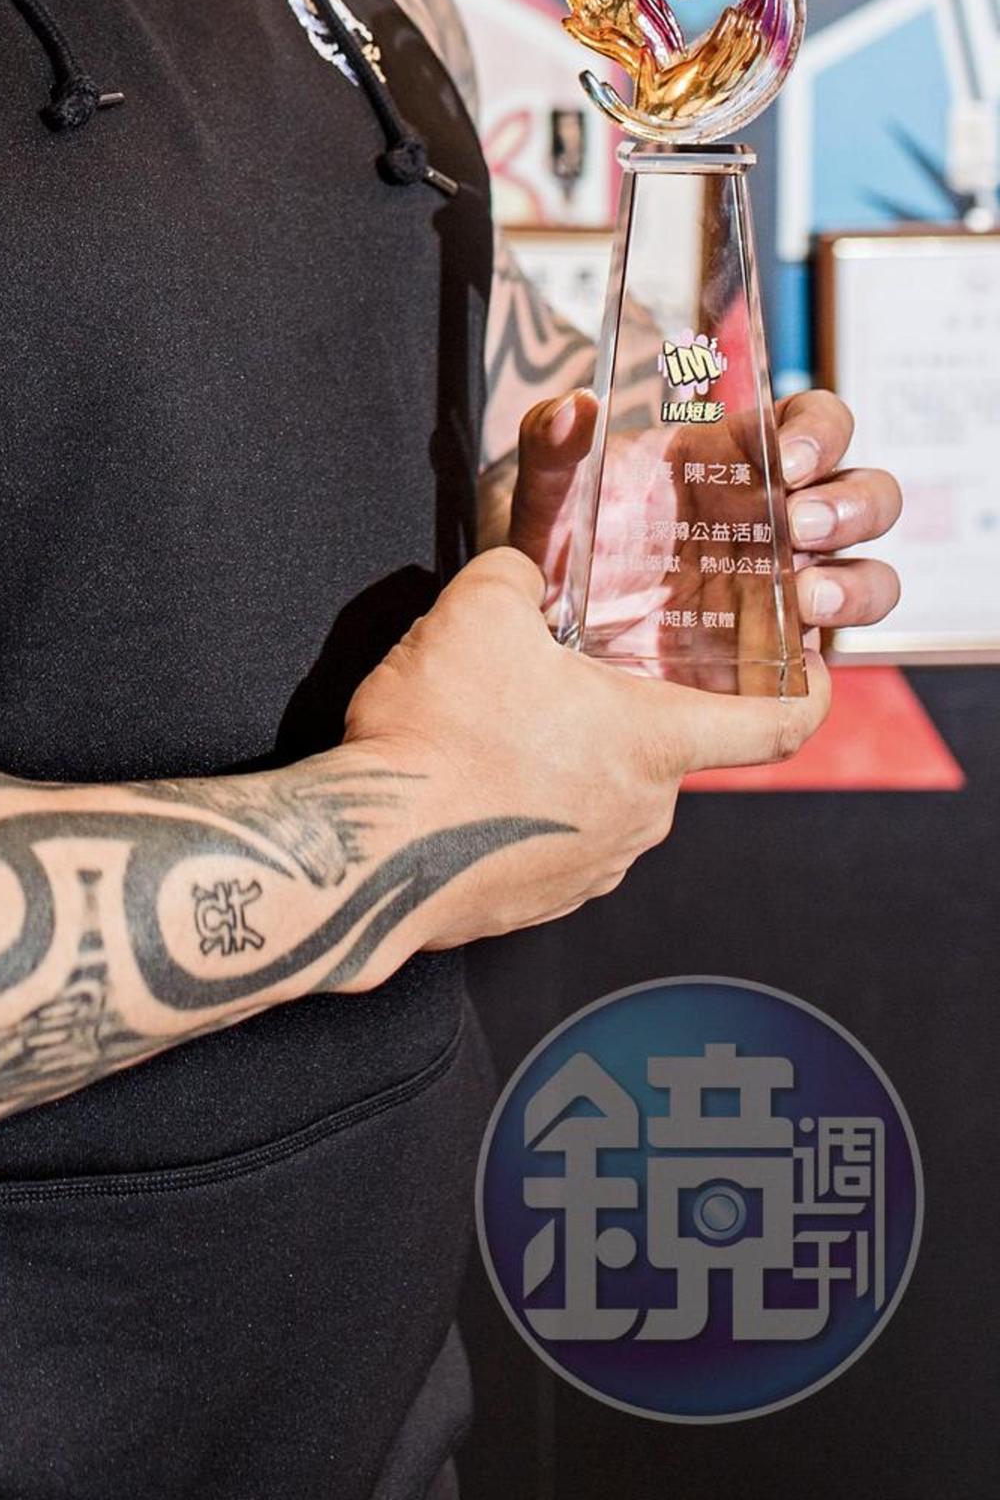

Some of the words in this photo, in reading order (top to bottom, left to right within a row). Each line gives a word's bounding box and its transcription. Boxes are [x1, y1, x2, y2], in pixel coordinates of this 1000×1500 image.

[684, 463, 751, 486] 陳之漢
[700, 556, 772, 575] 熱心公益
[701, 611, 735, 628] 敬贈
